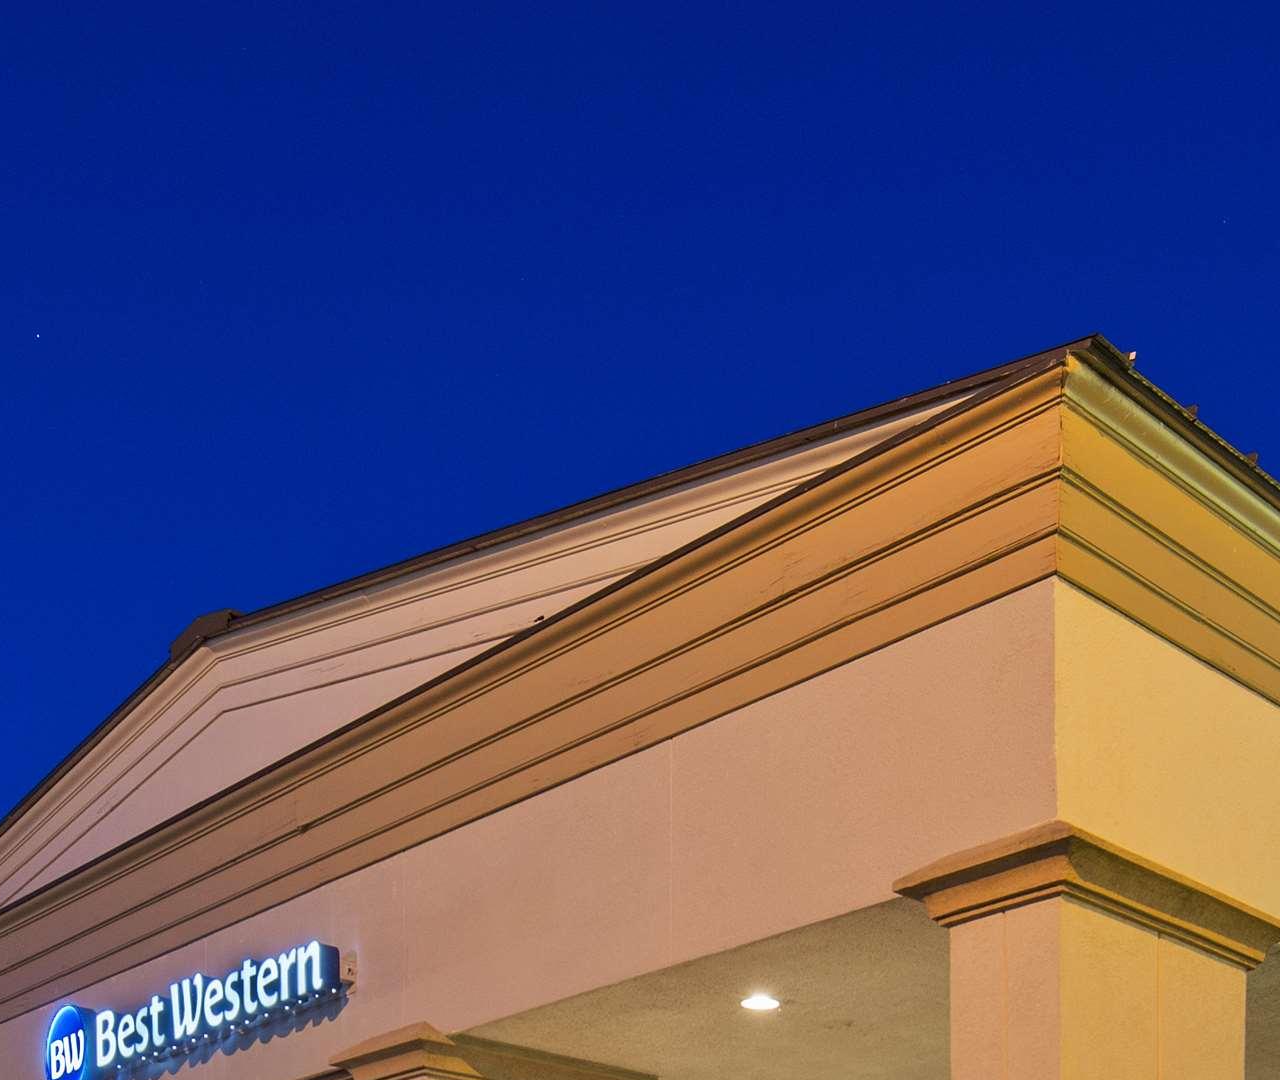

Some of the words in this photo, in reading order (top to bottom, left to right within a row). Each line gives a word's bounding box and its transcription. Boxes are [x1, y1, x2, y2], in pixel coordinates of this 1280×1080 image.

[50, 1028, 85, 1080] BW
[95, 994, 165, 1068] Best
[169, 939, 324, 1040] Western
